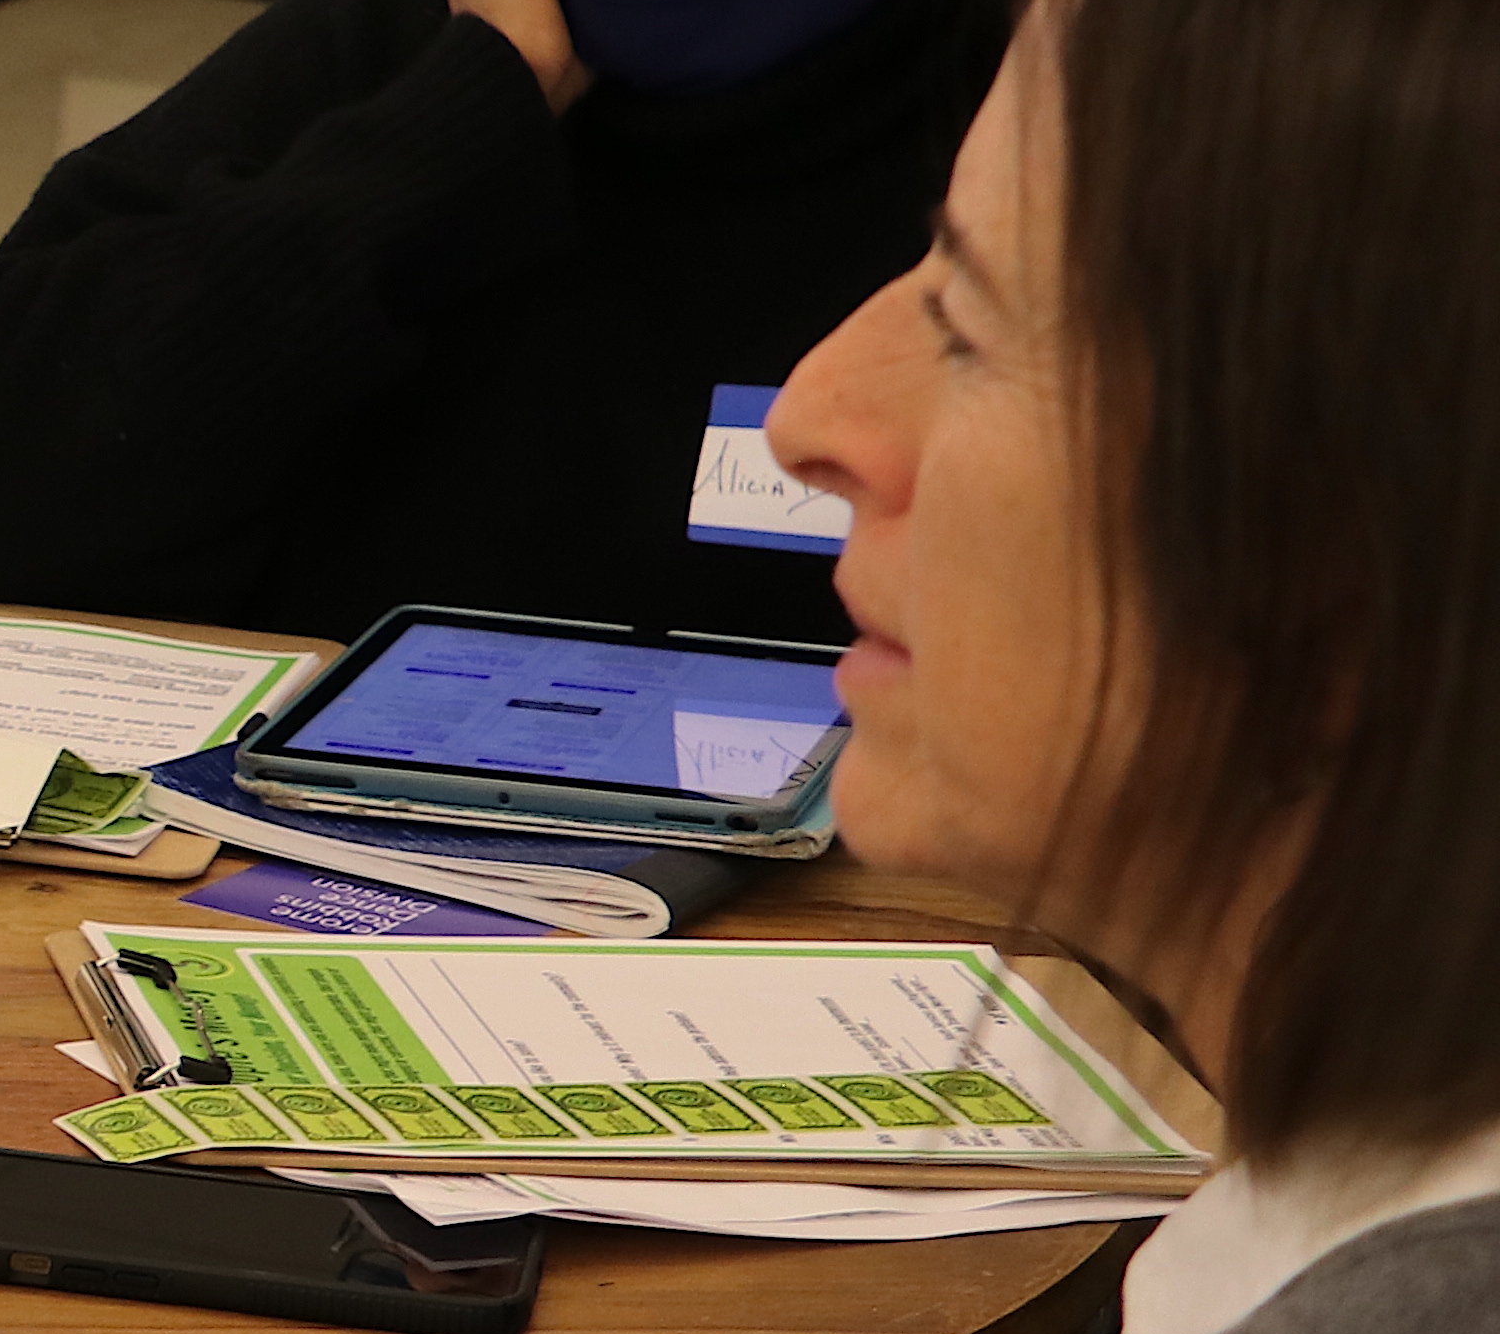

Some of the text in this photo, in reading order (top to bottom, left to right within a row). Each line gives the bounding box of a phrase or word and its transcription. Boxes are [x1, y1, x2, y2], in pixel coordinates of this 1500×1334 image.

[275, 894, 400, 932] Robbins
[312, 876, 439, 914] Division
[319, 892, 419, 922] Dance
